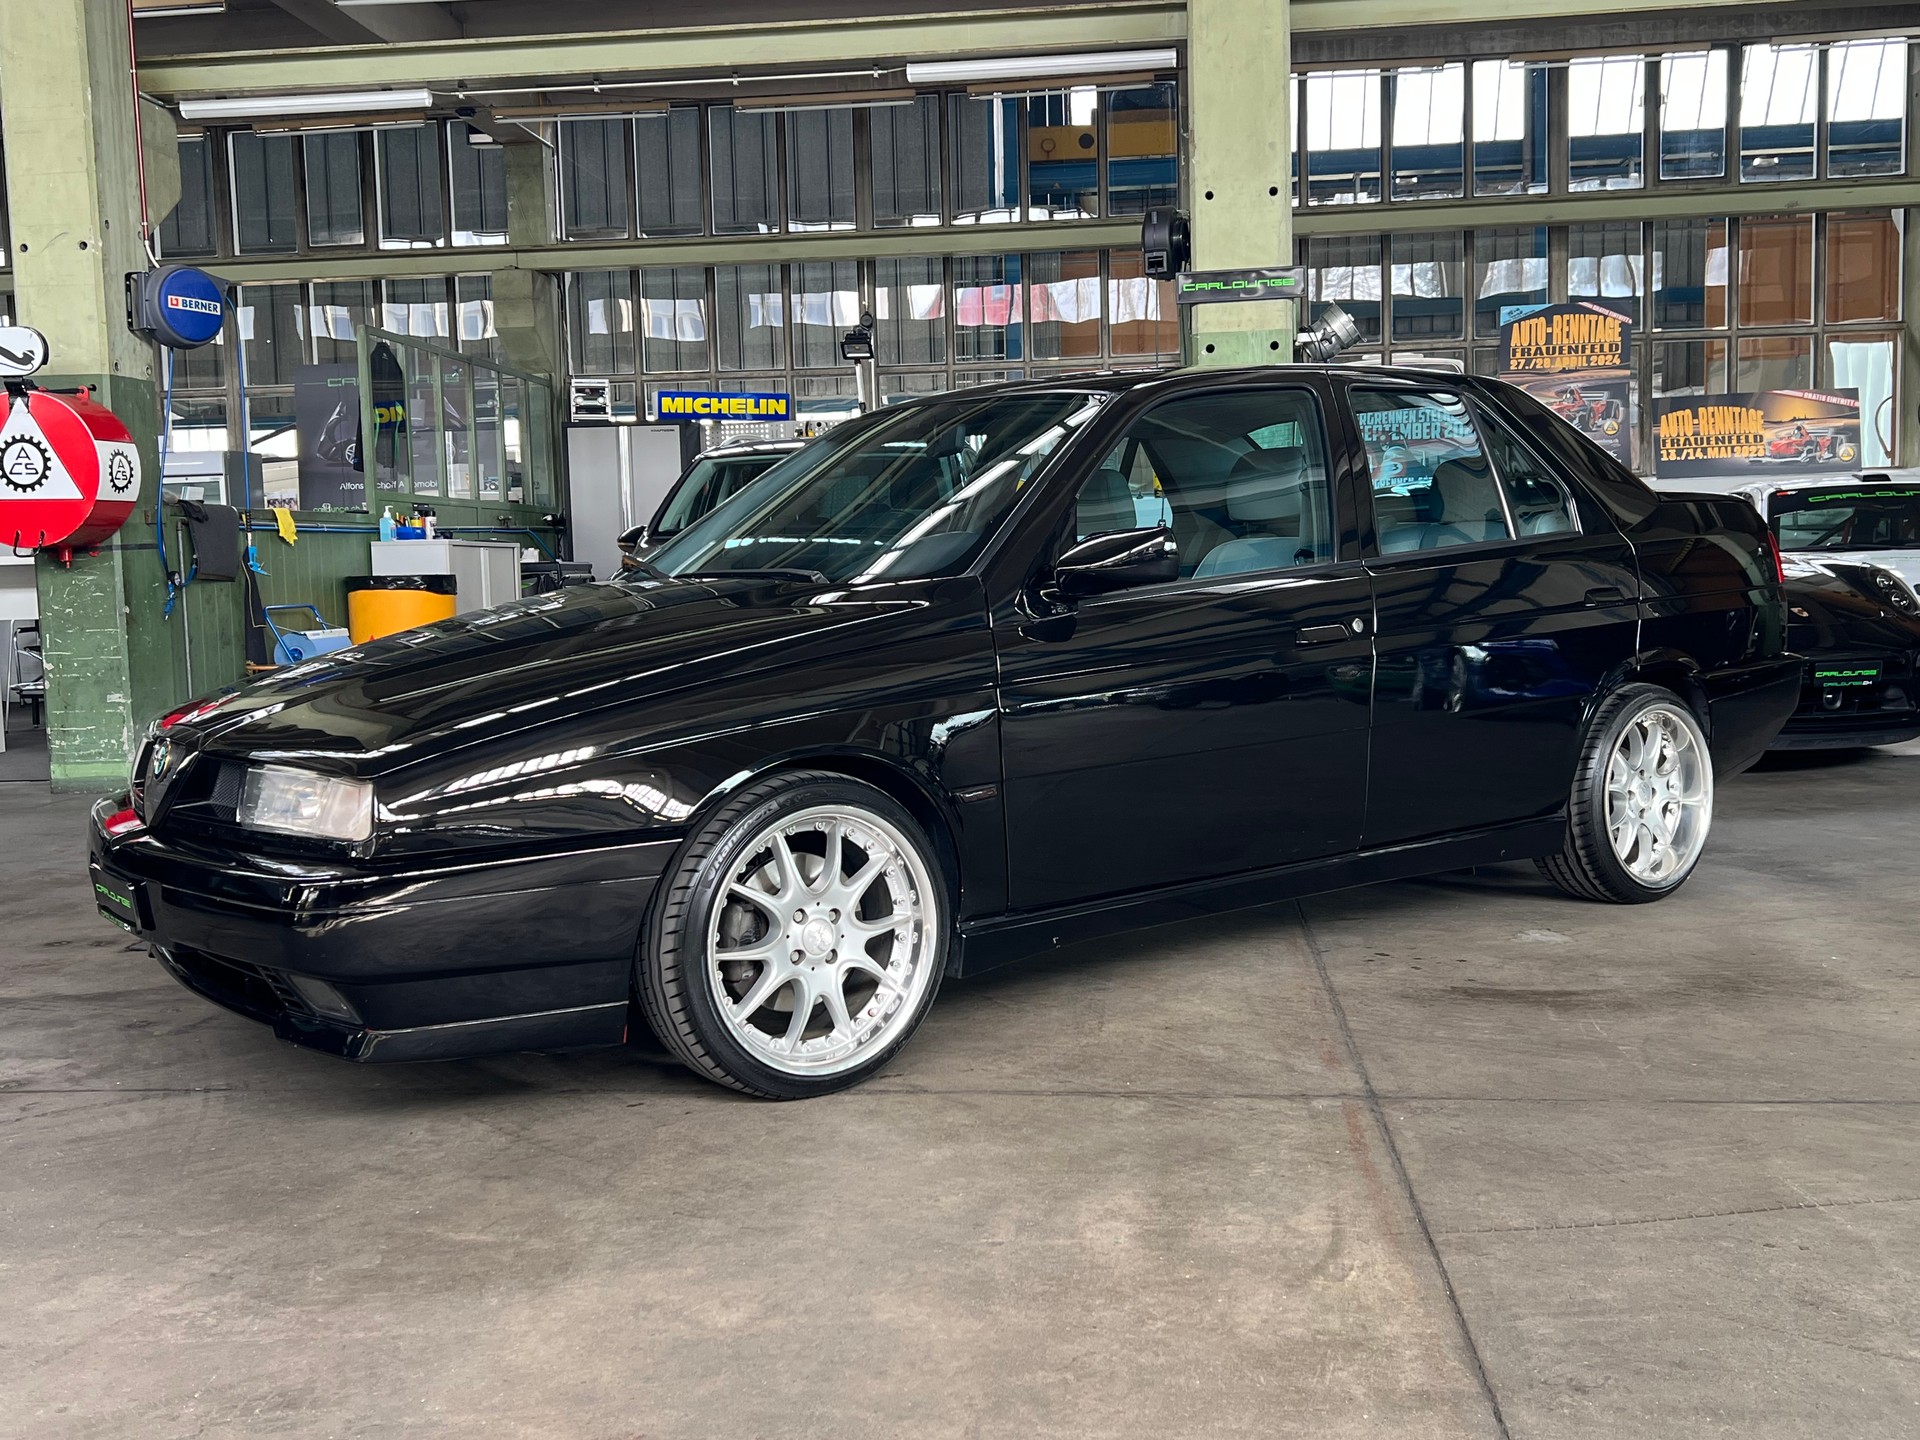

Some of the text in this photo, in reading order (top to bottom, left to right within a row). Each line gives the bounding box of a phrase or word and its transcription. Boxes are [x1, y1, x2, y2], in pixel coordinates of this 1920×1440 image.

[1183, 278, 1295, 291] CARLOUNGE
[181, 299, 219, 313] BERNER
[1510, 314, 1622, 346] AUTO-RENNTAGE
[1511, 343, 1620, 357] FRAUENFELD
[1590, 354, 1621, 366] 2024
[661, 397, 786, 415] MICHELIN
[1357, 409, 1416, 426] RGRENNEN
[1660, 406, 1765, 437] AUTO-RENNTAGE
[1661, 434, 1764, 448] FRAUENFELD
[16, 446, 31, 460] A
[1733, 445, 1765, 458] 2023
[340, 481, 364, 490] Alfons
[1815, 669, 1877, 678] CARLOUNGE
